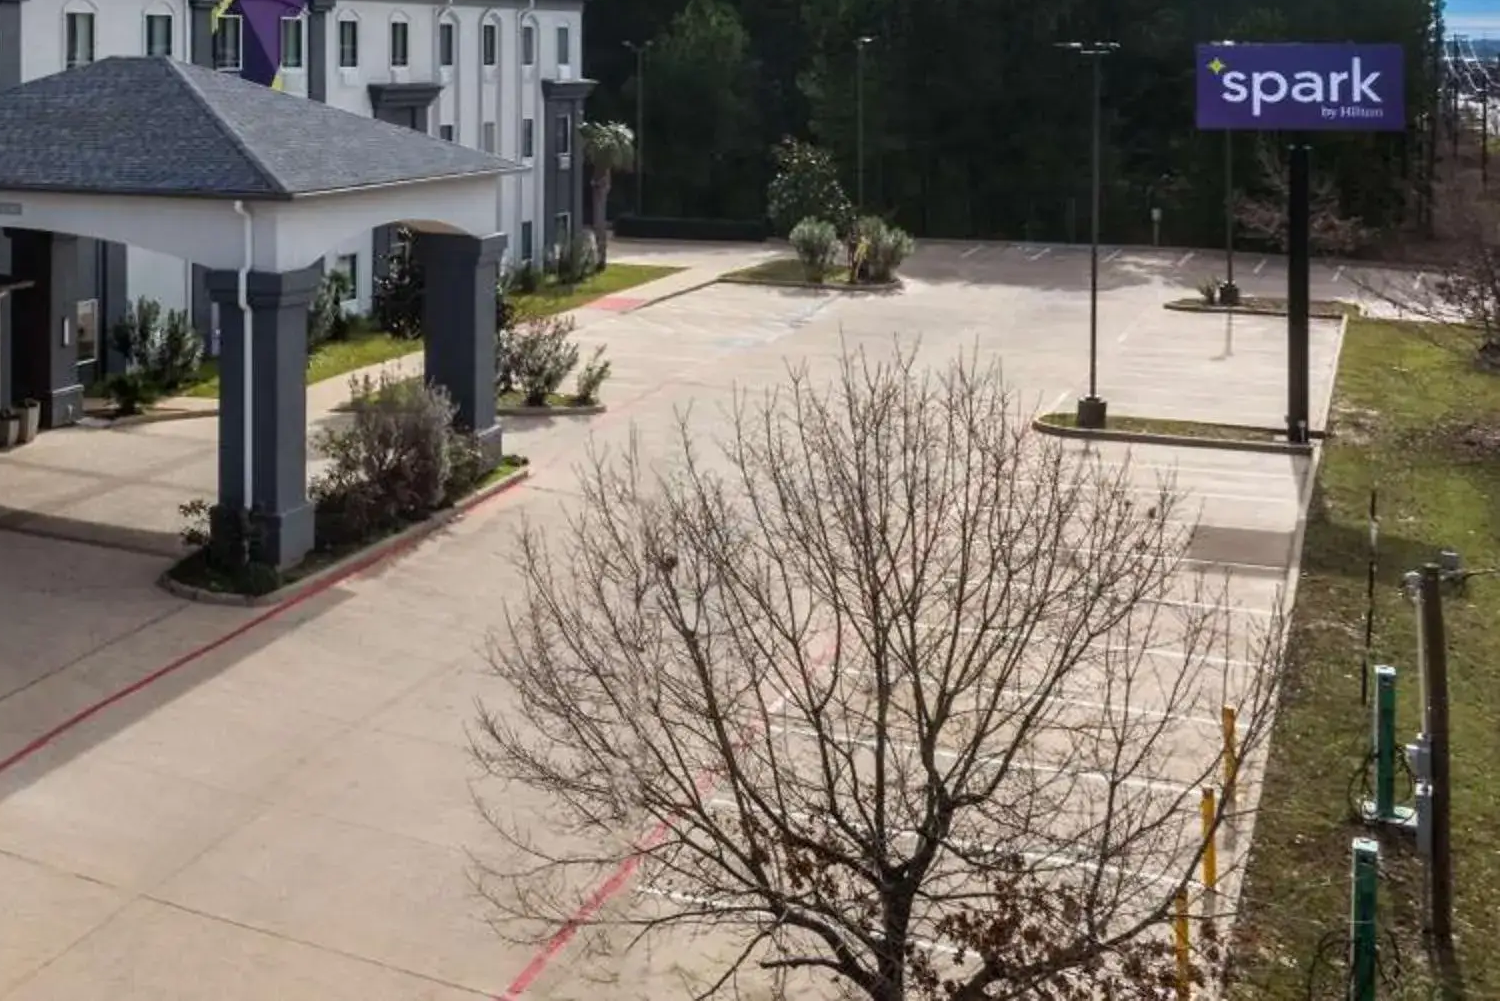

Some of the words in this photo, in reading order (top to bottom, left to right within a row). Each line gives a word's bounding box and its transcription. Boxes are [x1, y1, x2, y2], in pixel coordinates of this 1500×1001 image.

[1221, 56, 1383, 117] spark
[1321, 105, 1337, 120] by
[1340, 106, 1384, 118] Hilton
